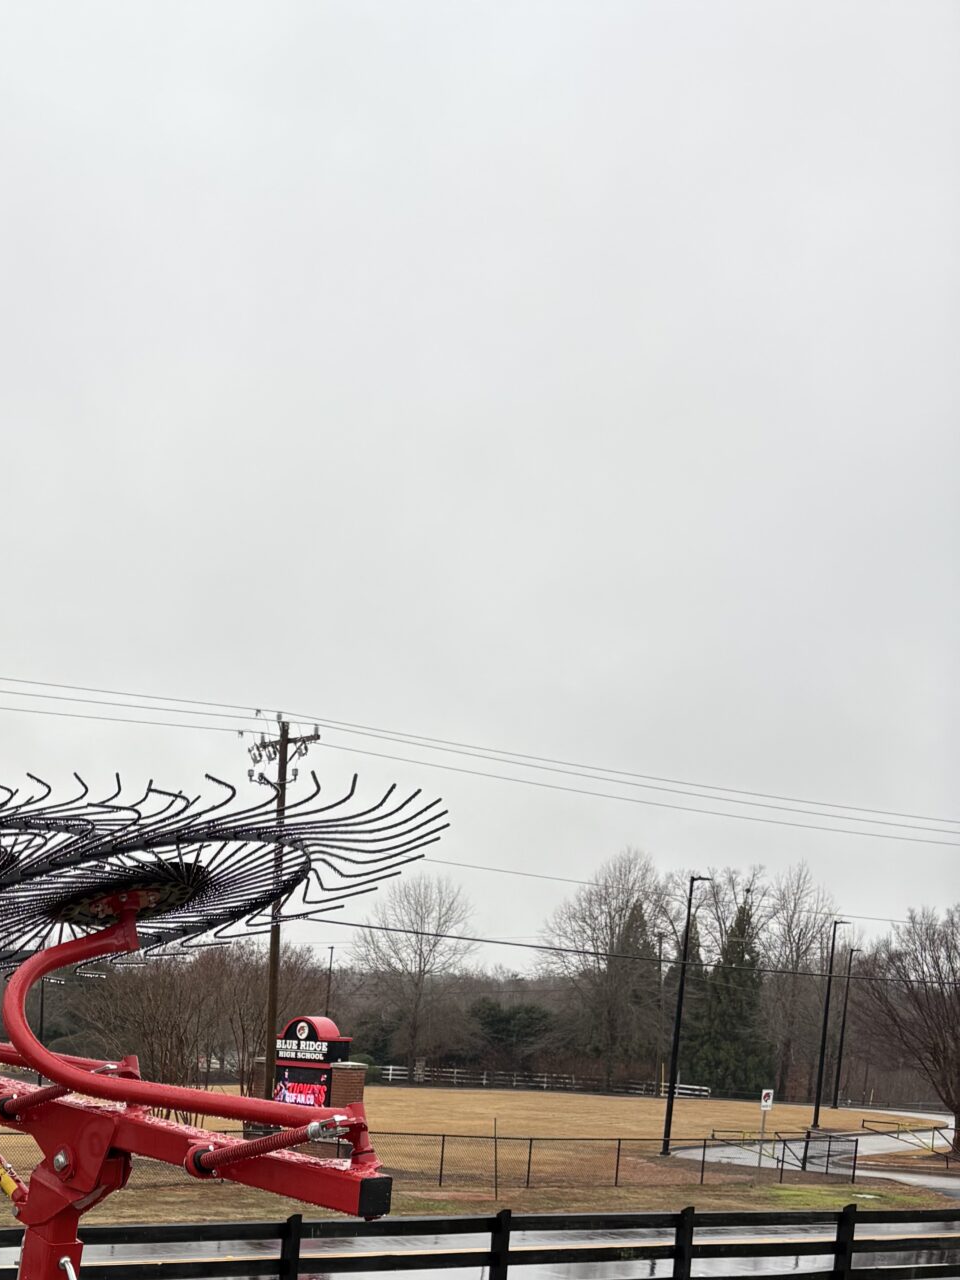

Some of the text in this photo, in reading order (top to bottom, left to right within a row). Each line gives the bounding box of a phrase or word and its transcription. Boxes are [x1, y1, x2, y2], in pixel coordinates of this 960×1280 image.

[276, 1039, 328, 1051] BLUE RIDGE
[278, 1050, 324, 1060] HIGH SCHOOL
